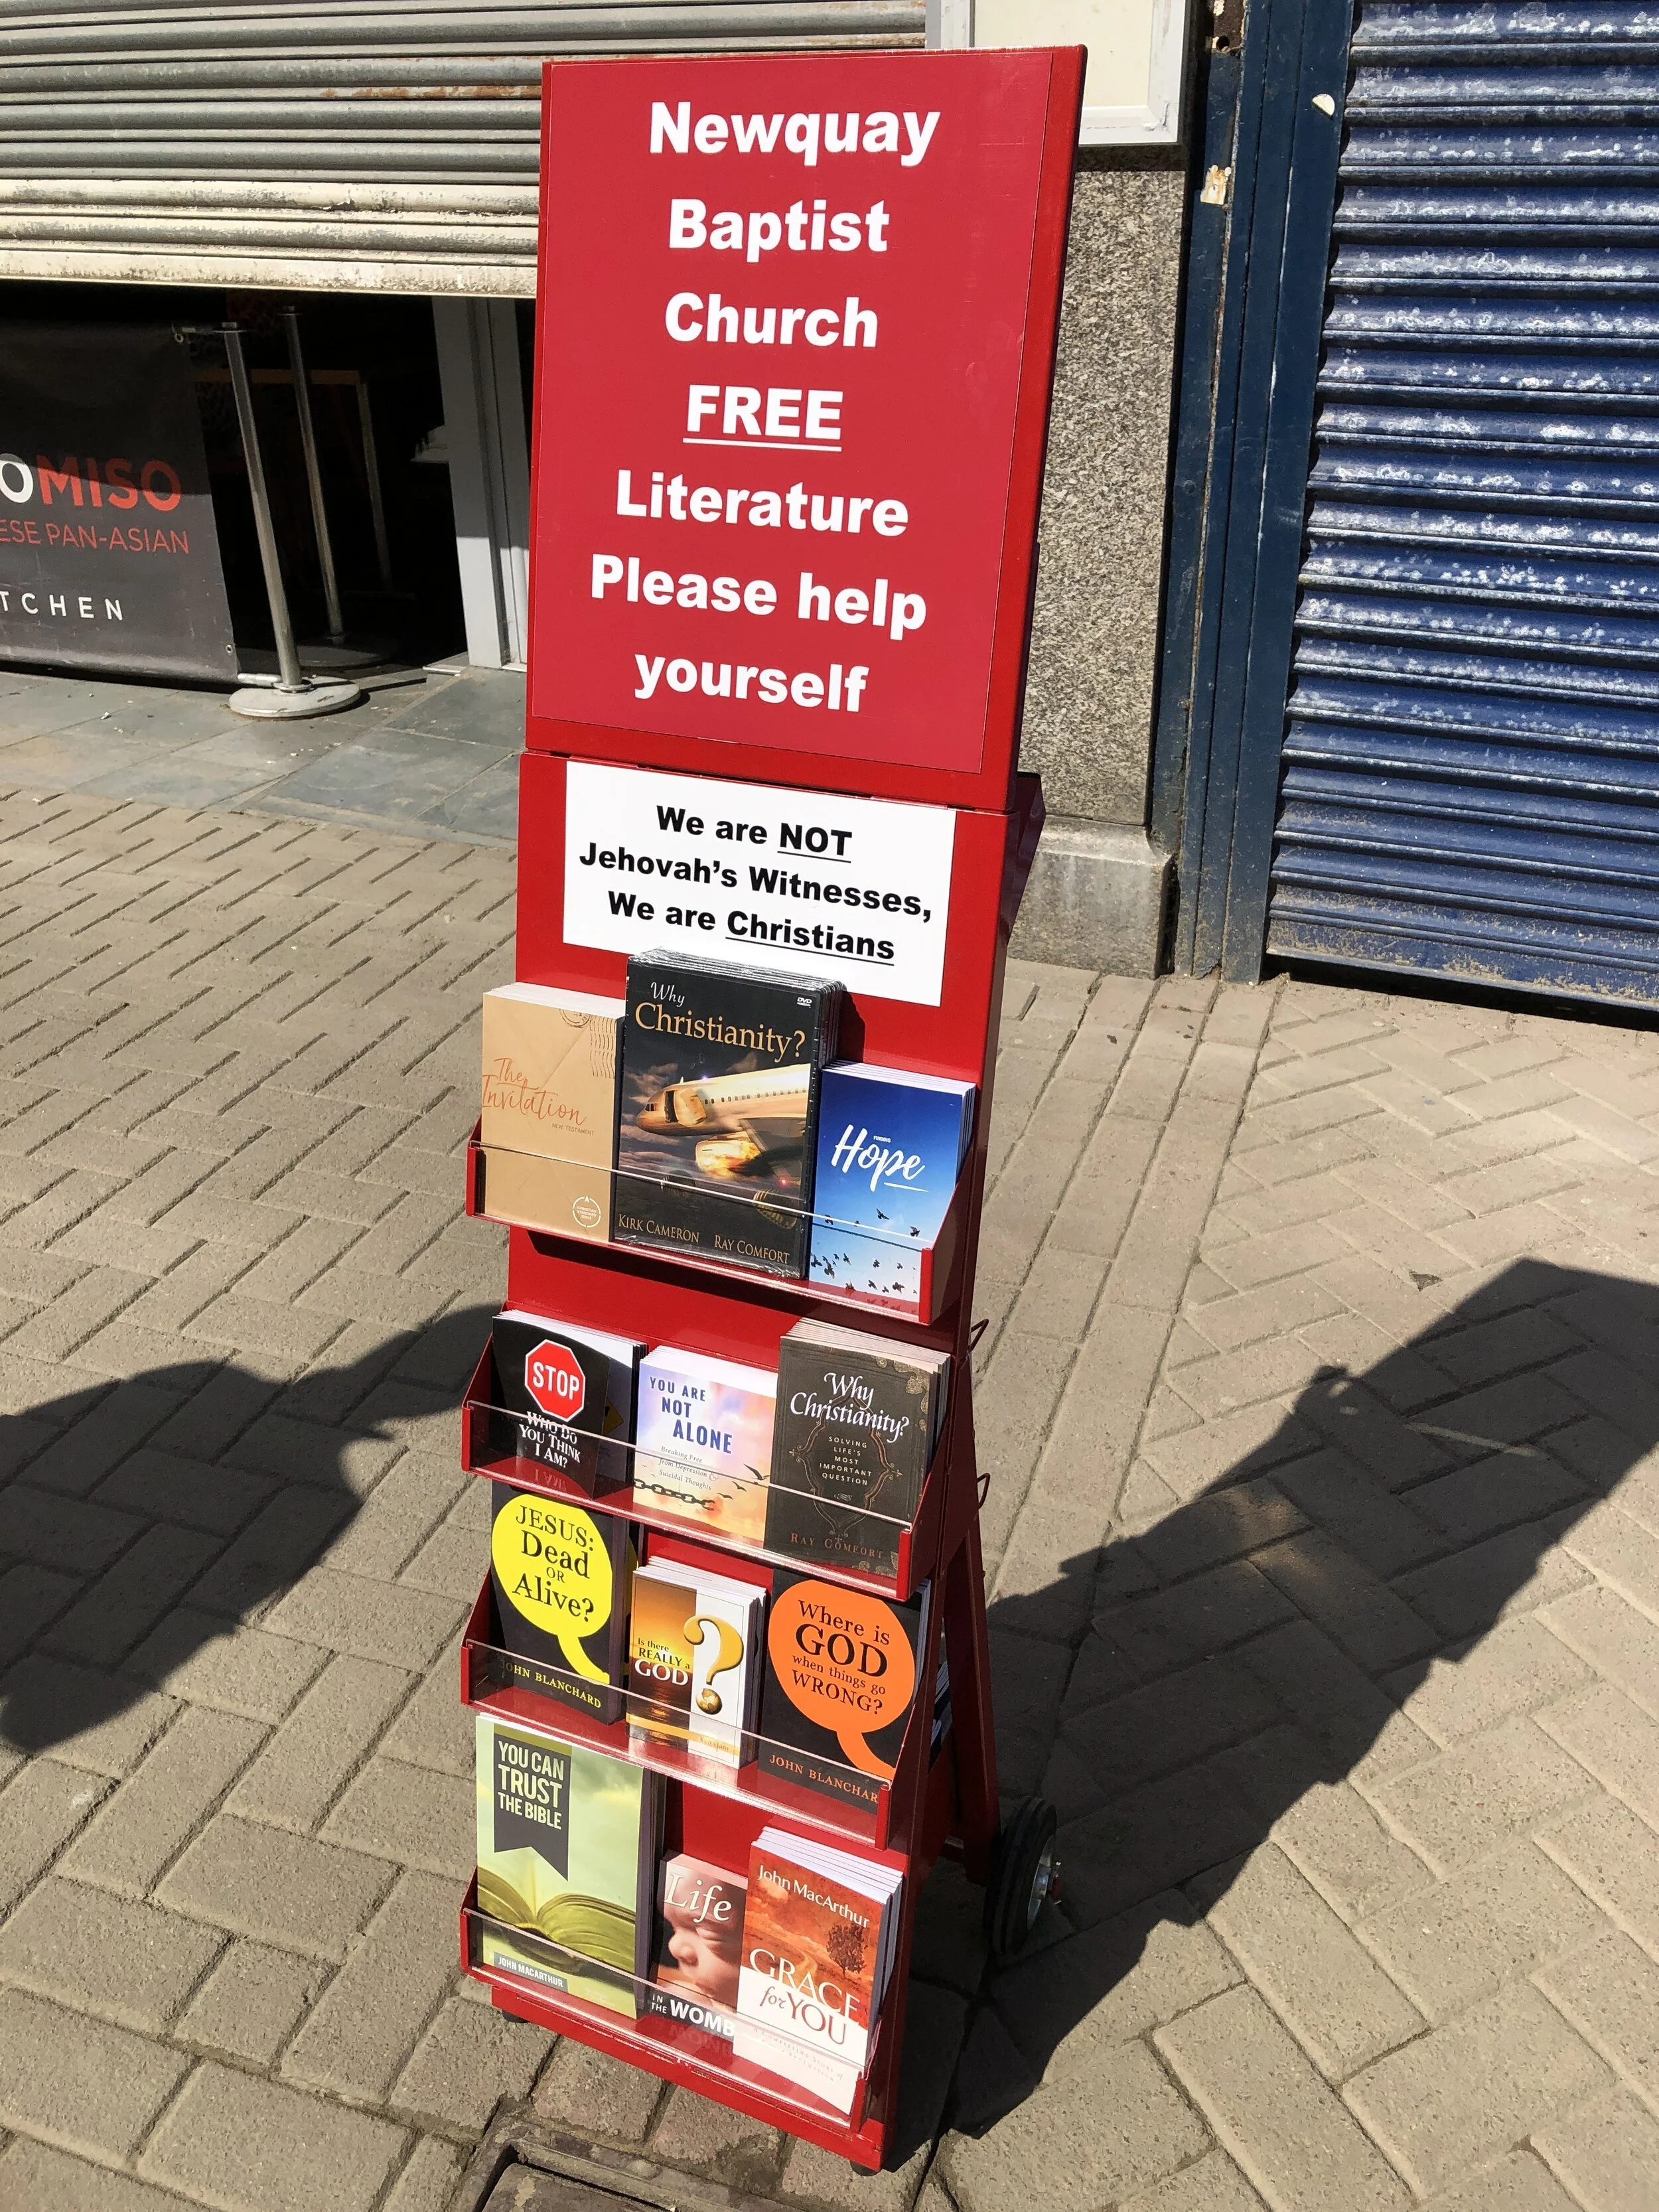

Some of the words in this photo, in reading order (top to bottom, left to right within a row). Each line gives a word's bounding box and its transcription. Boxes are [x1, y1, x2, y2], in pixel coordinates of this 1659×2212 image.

[649, 101, 941, 167] Newquay
[668, 198, 891, 263] Baptist
[664, 291, 879, 348] Church
[685, 383, 843, 443] FREE
[616, 469, 909, 537] Literature
[44, 522, 190, 555] PAN-ASIAN
[591, 553, 778, 616] Please
[798, 571, 927, 641] help
[634, 653, 870, 713] yourself
[656, 804, 705, 835] We
[715, 818, 768, 845] are
[778, 822, 853, 857] NOT
[579, 842, 738, 888] Jehovah's
[749, 865, 932, 924] Witnesses,
[608, 890, 655, 921] We
[665, 903, 716, 930] are
[726, 910, 895, 961] Christians
[650, 981, 685, 1008] Why
[634, 1001, 806, 1063] Christianity?
[493, 1057, 526, 1083] The
[482, 1074, 587, 1126] Invitation
[565, 1124, 595, 1137] TESTAMENT
[831, 1124, 926, 1193] Hope
[618, 1213, 644, 1232] KIRK
[646, 1220, 700, 1244] CAMERON
[714, 1234, 735, 1252] RAY
[736, 1240, 790, 1264] COMFORT
[532, 1361, 580, 1400] STOP
[649, 1376, 676, 1394] YOU
[682, 1385, 706, 1402] ARE
[823, 1372, 875, 1408] Why
[661, 1396, 692, 1418] NOT
[790, 1392, 910, 1443] Christianity?
[518, 1424, 545, 1444] YOU
[548, 1434, 581, 1463] THINK
[526, 1411, 558, 1434] WHO
[561, 1425, 577, 1445] DO
[672, 1418, 733, 1454] ALONE
[828, 1435, 868, 1449] SOLVING
[535, 1443, 541, 1457] I
[543, 1447, 568, 1468] AM?
[658, 1457, 675, 1468] from
[675, 1461, 708, 1479] Depression
[660, 1445, 689, 1461] Breaking
[689, 1453, 703, 1464] Free
[818, 1463, 872, 1477] IMPORTANT
[833, 1445, 861, 1457] LIFE'S
[833, 1455, 859, 1465] MOST
[658, 1469, 684, 1482] Suicidal
[684, 1475, 712, 1491] Thoughts
[821, 1472, 869, 1486] QUESTION
[515, 1505, 594, 1552] JESUS:
[790, 1532, 816, 1546] RAY
[824, 1538, 884, 1559] COMFORT
[520, 1529, 591, 1580] Dead
[545, 1566, 565, 1584] OR
[512, 1572, 595, 1623] Alive?
[798, 1599, 865, 1637] Where
[873, 1625, 891, 1646] is
[637, 1637, 645, 1646] Is
[647, 1640, 670, 1653] there
[638, 1647, 683, 1666] REALLY
[795, 1623, 888, 1678] GOD
[500, 1659, 530, 1678] JOHN
[534, 1671, 602, 1709] BLANCHARD
[634, 1659, 689, 1686] GOD
[791, 1668, 883, 1715] WRONG?
[792, 1654, 824, 1674] when
[829, 1666, 866, 1688] things
[870, 1683, 886, 1696] go
[498, 1739, 530, 1769] YOU
[531, 1751, 564, 1781] CAN
[769, 1754, 804, 1775] JOHN
[808, 1769, 879, 1804] BLANCHAR
[498, 1763, 563, 1809] TRUST
[498, 1791, 523, 1817] THE
[525, 1799, 563, 1831] BIBLE
[664, 1873, 732, 1923] Life
[758, 1864, 790, 1890] John
[793, 1882, 870, 1929] MacArthur
[498, 1955, 517, 1972] JOHN
[518, 1962, 563, 1988] MACARTHUR
[749, 1947, 861, 2026] GRACE
[650, 2002, 667, 2014] THE
[652, 1993, 664, 2004] IN
[669, 1998, 735, 2037] WOMB
[759, 1986, 786, 2010] for
[786, 1992, 846, 2045] YOU
